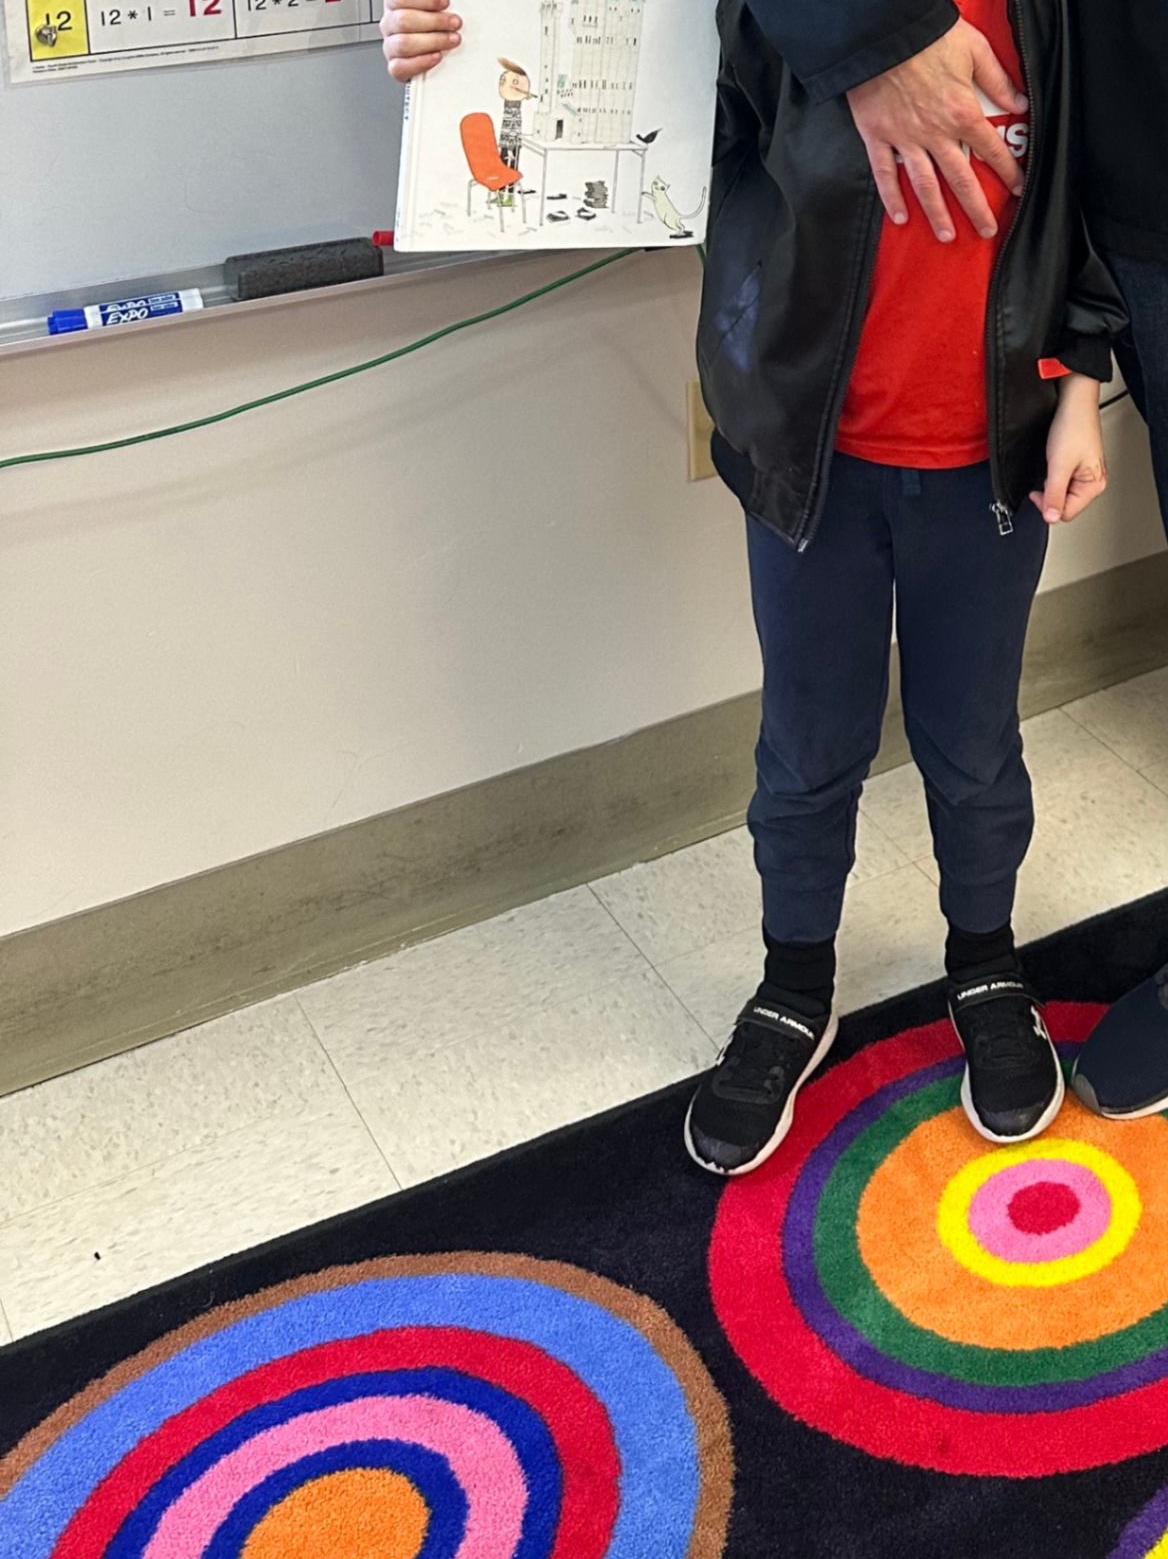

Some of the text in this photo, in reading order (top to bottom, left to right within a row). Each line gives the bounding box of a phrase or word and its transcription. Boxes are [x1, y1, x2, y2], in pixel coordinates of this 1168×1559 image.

[105, 307, 149, 325] EXPO
[956, 984, 988, 1001] UNDER
[753, 1006, 780, 1021] UNDER
